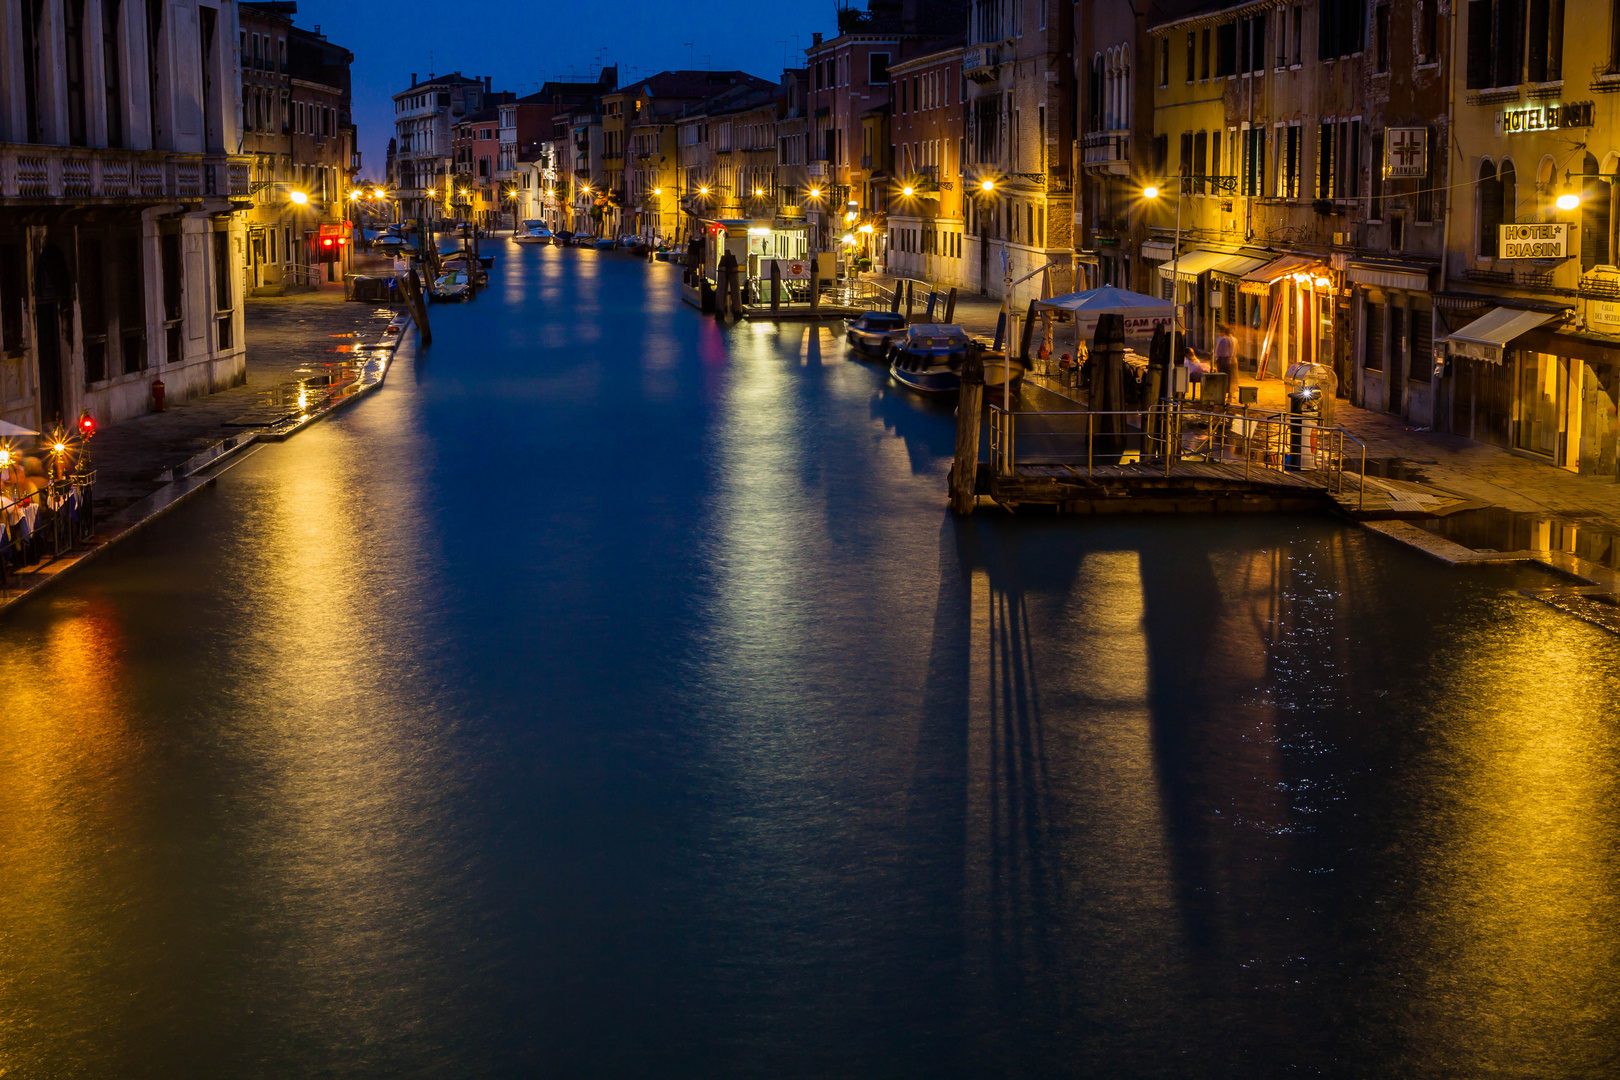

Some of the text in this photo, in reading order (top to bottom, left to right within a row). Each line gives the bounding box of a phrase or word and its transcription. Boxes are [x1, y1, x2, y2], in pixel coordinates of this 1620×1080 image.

[1504, 109, 1544, 131] HOTEL
[1392, 166, 1421, 175] FARMACIA
[1505, 226, 1556, 240] HOTEL
[1506, 243, 1561, 257] BIASIN
[1125, 318, 1149, 328] GAM
